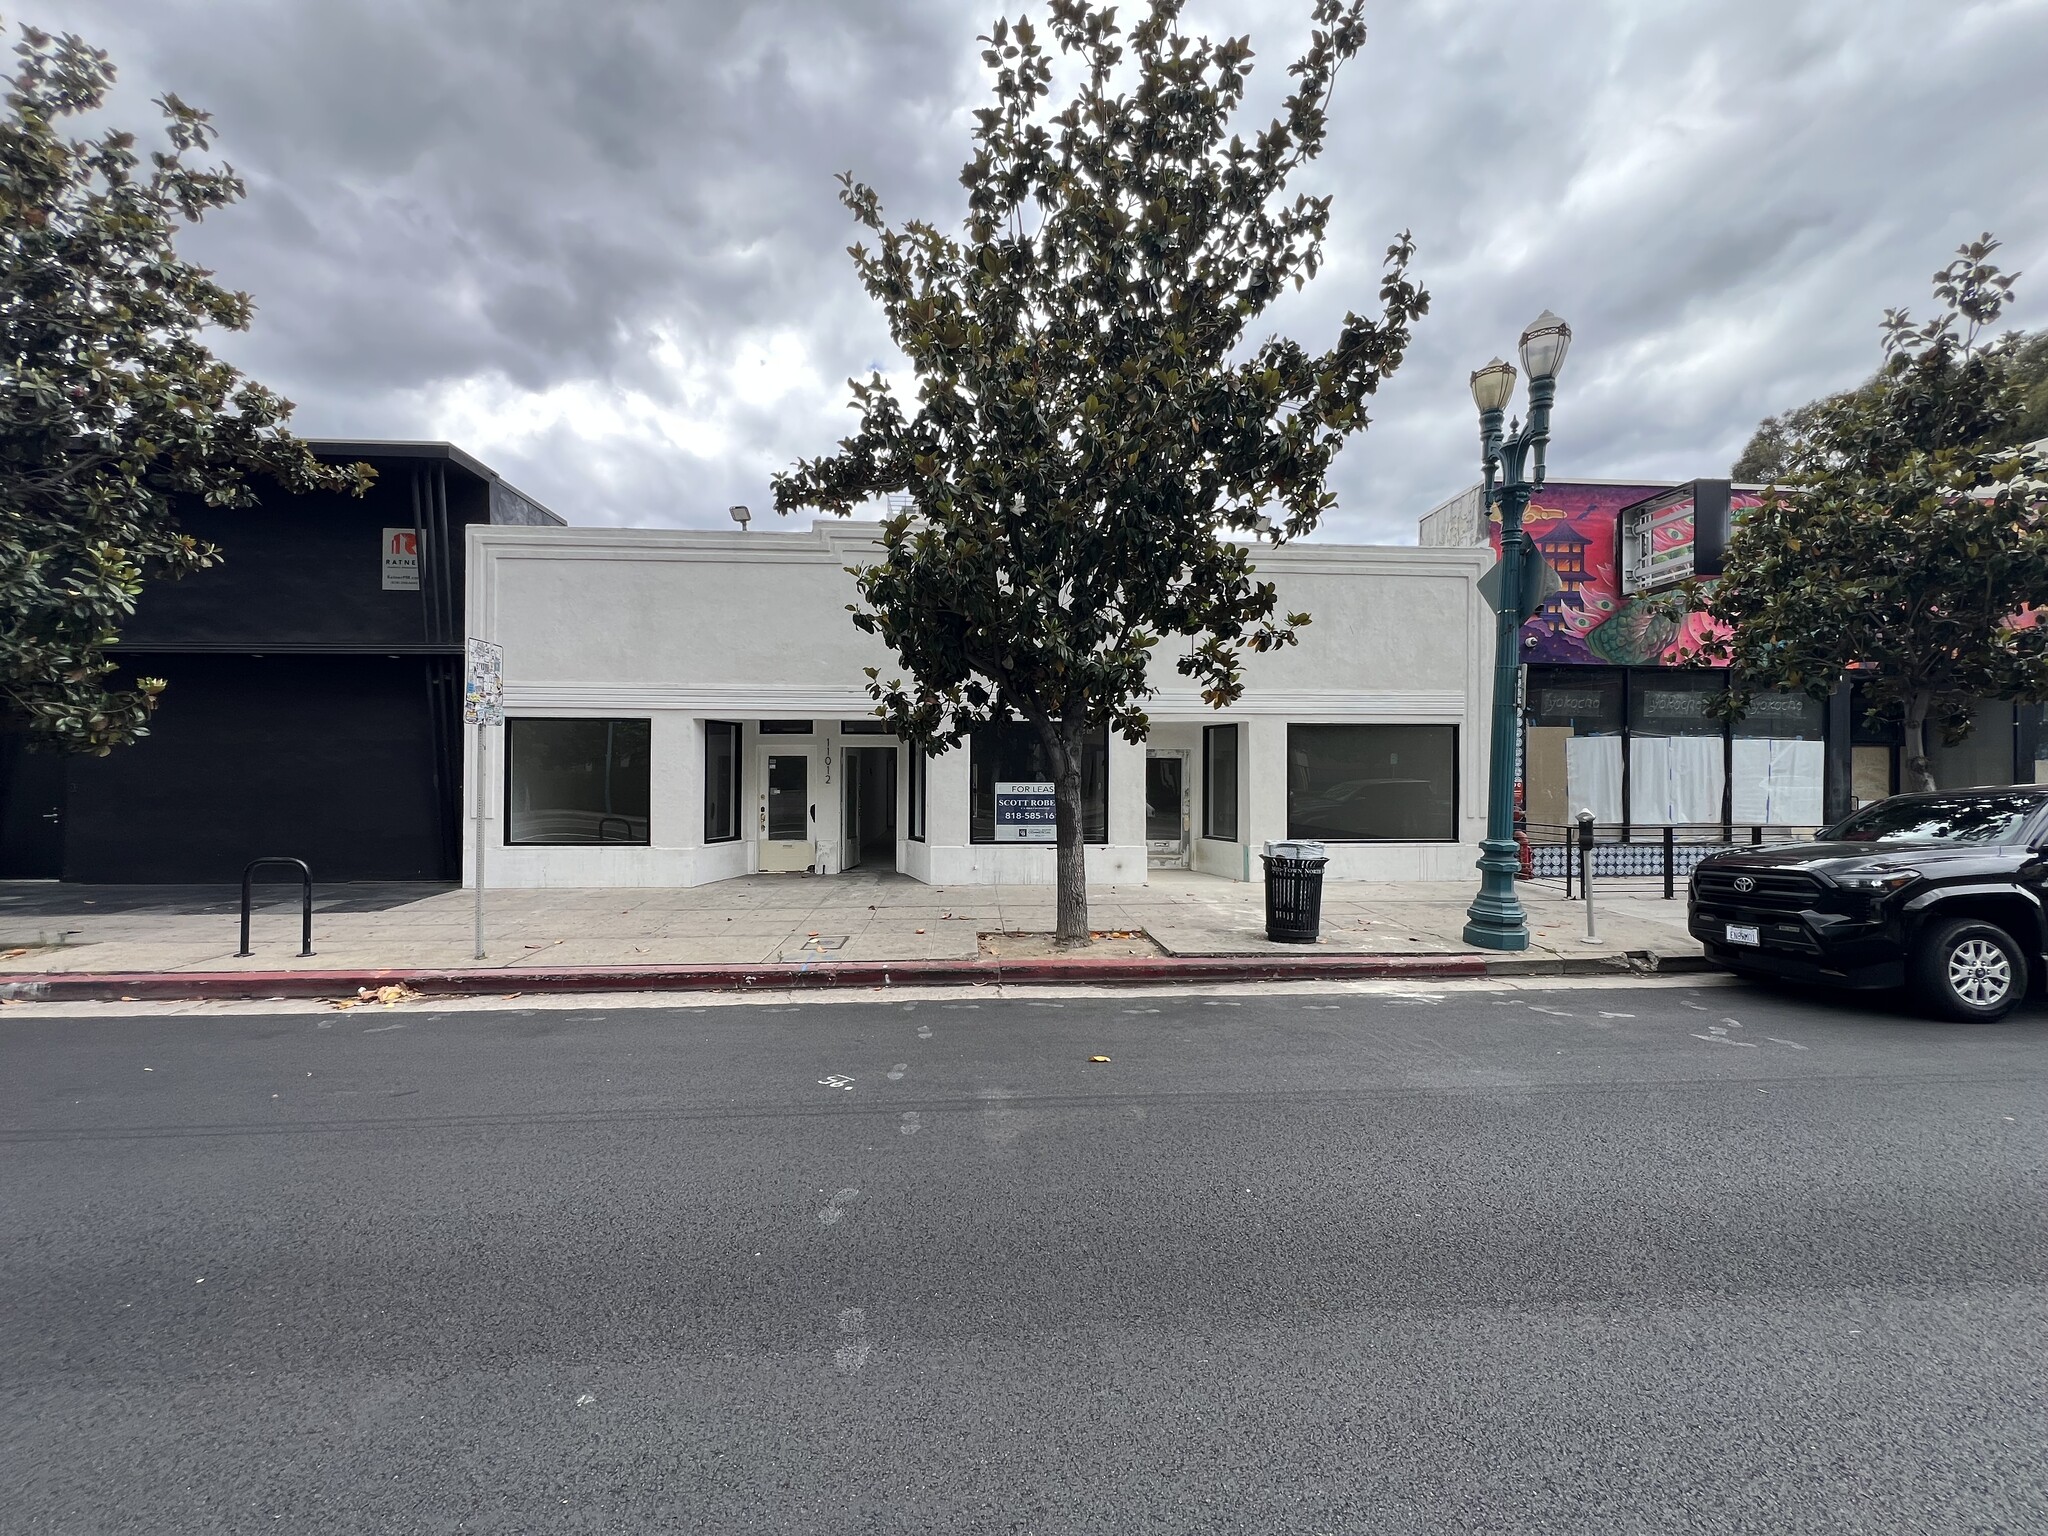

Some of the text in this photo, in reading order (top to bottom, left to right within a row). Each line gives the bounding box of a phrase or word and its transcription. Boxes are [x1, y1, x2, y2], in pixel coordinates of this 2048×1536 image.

[1011, 785, 1055, 793] FOR LEAS
[998, 799, 1056, 807] SCOTT ROBE
[1005, 812, 1056, 820] 818-585-16
